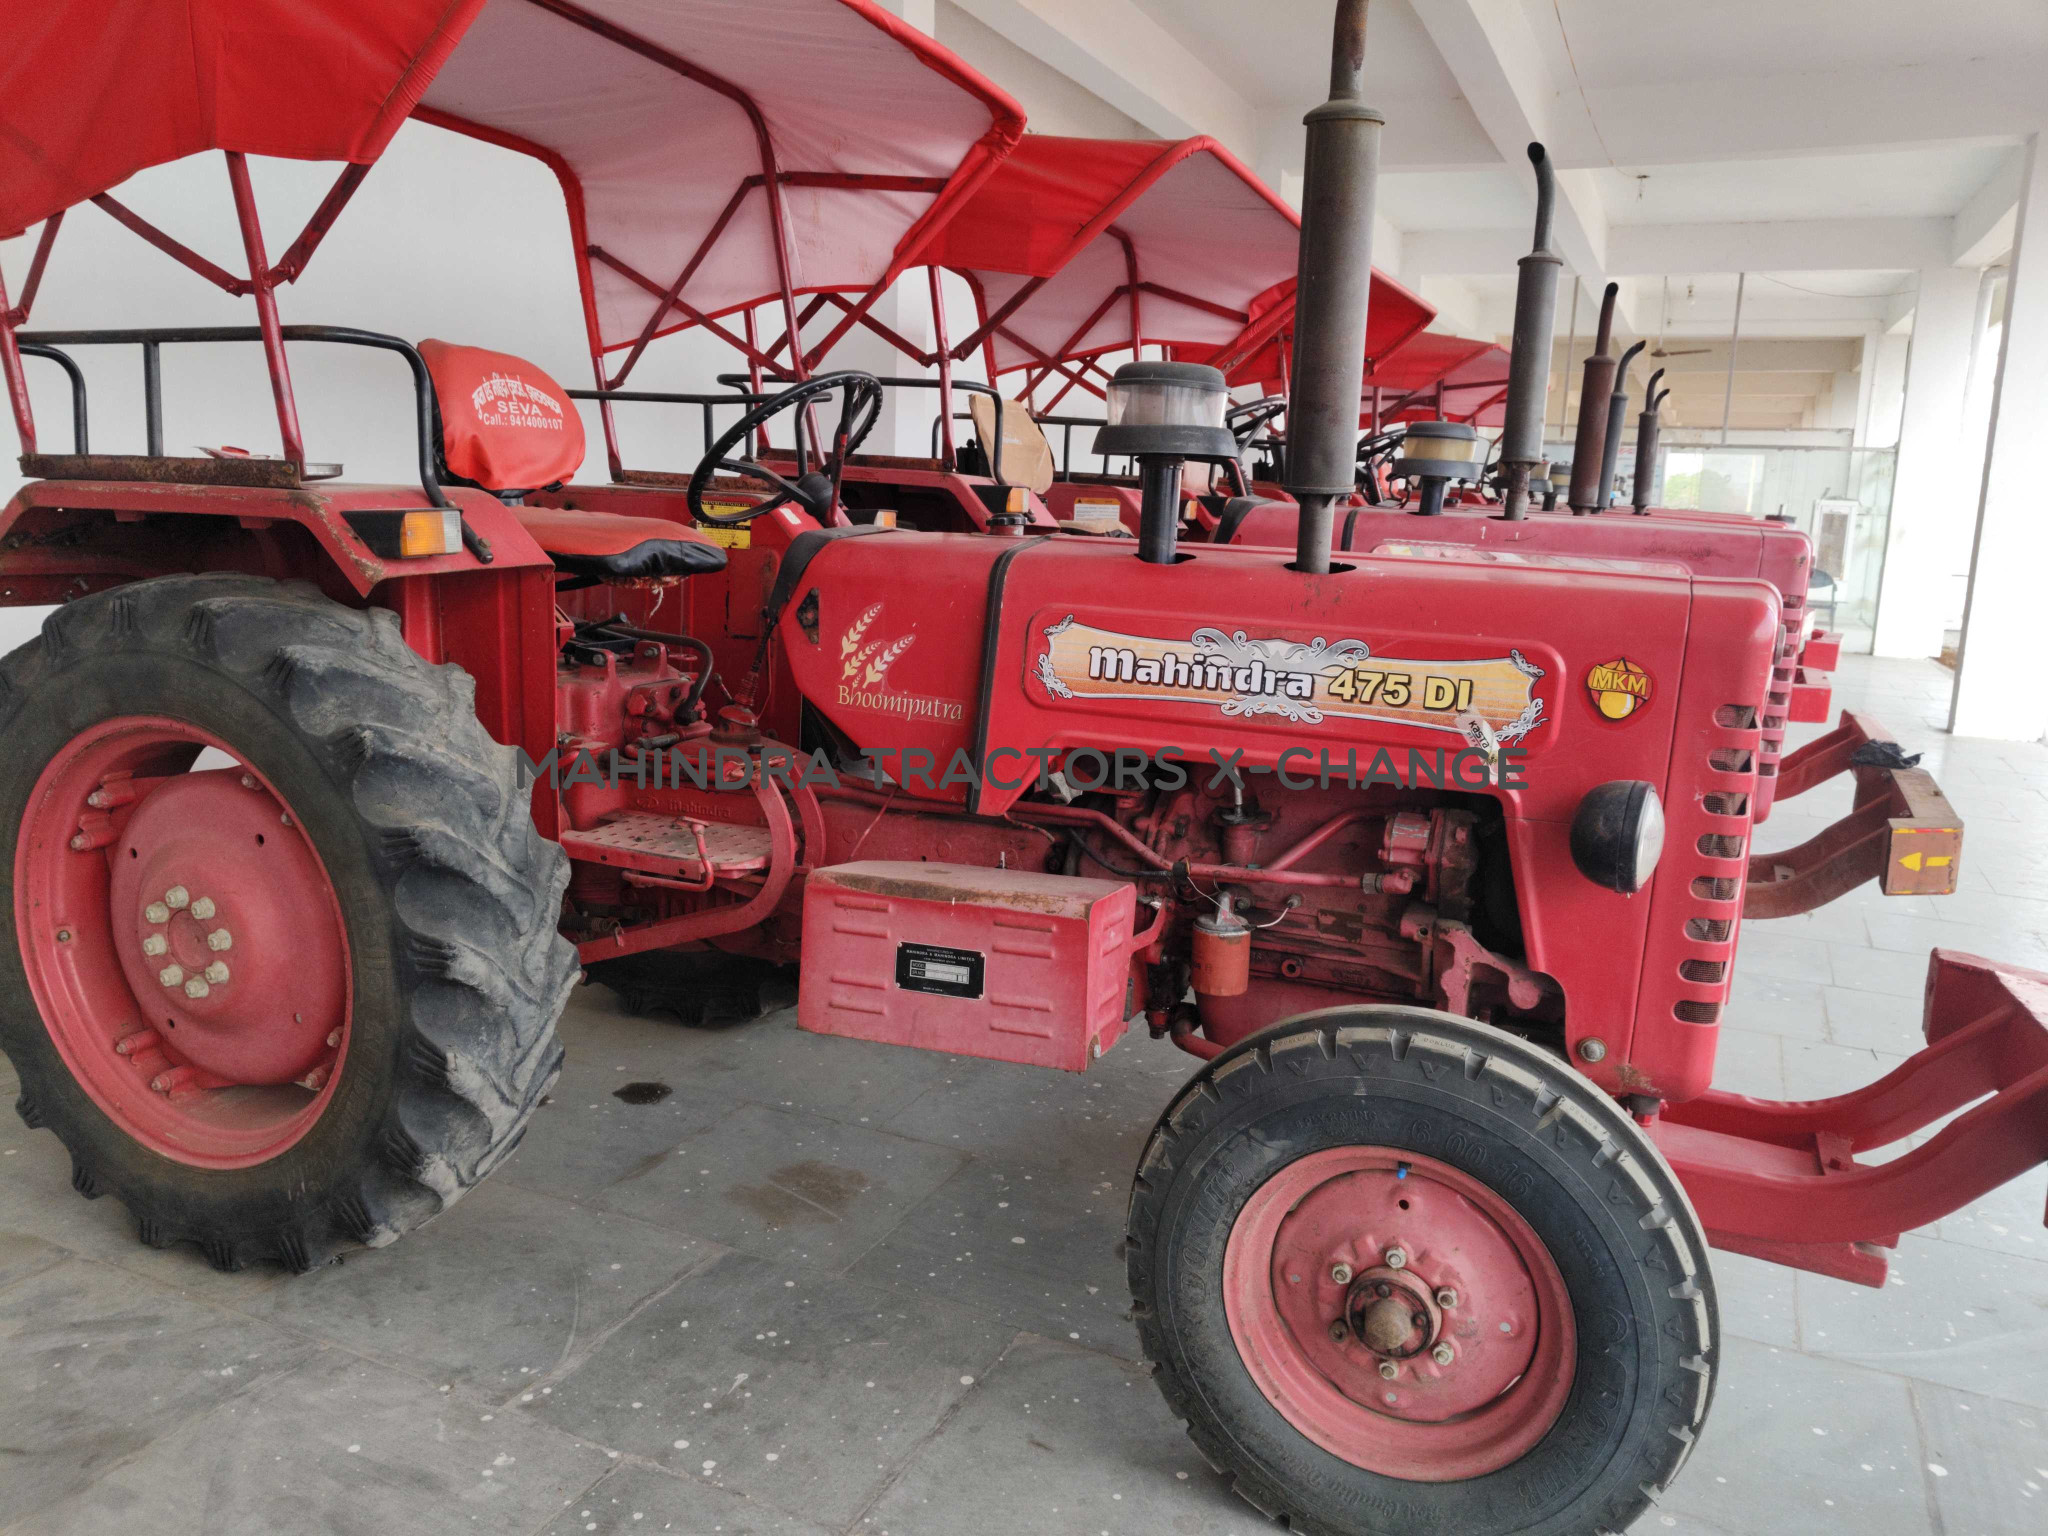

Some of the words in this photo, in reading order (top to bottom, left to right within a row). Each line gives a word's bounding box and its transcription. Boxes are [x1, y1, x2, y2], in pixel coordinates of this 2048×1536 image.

[497, 401, 542, 416] SEVA
[510, 414, 563, 430] 9414000107
[1088, 646, 1315, 699] Mahindra
[1326, 669, 1411, 707] 475
[1422, 675, 1474, 712] DI
[1591, 666, 1647, 696] MKM
[837, 685, 963, 721] Bhoomiputra
